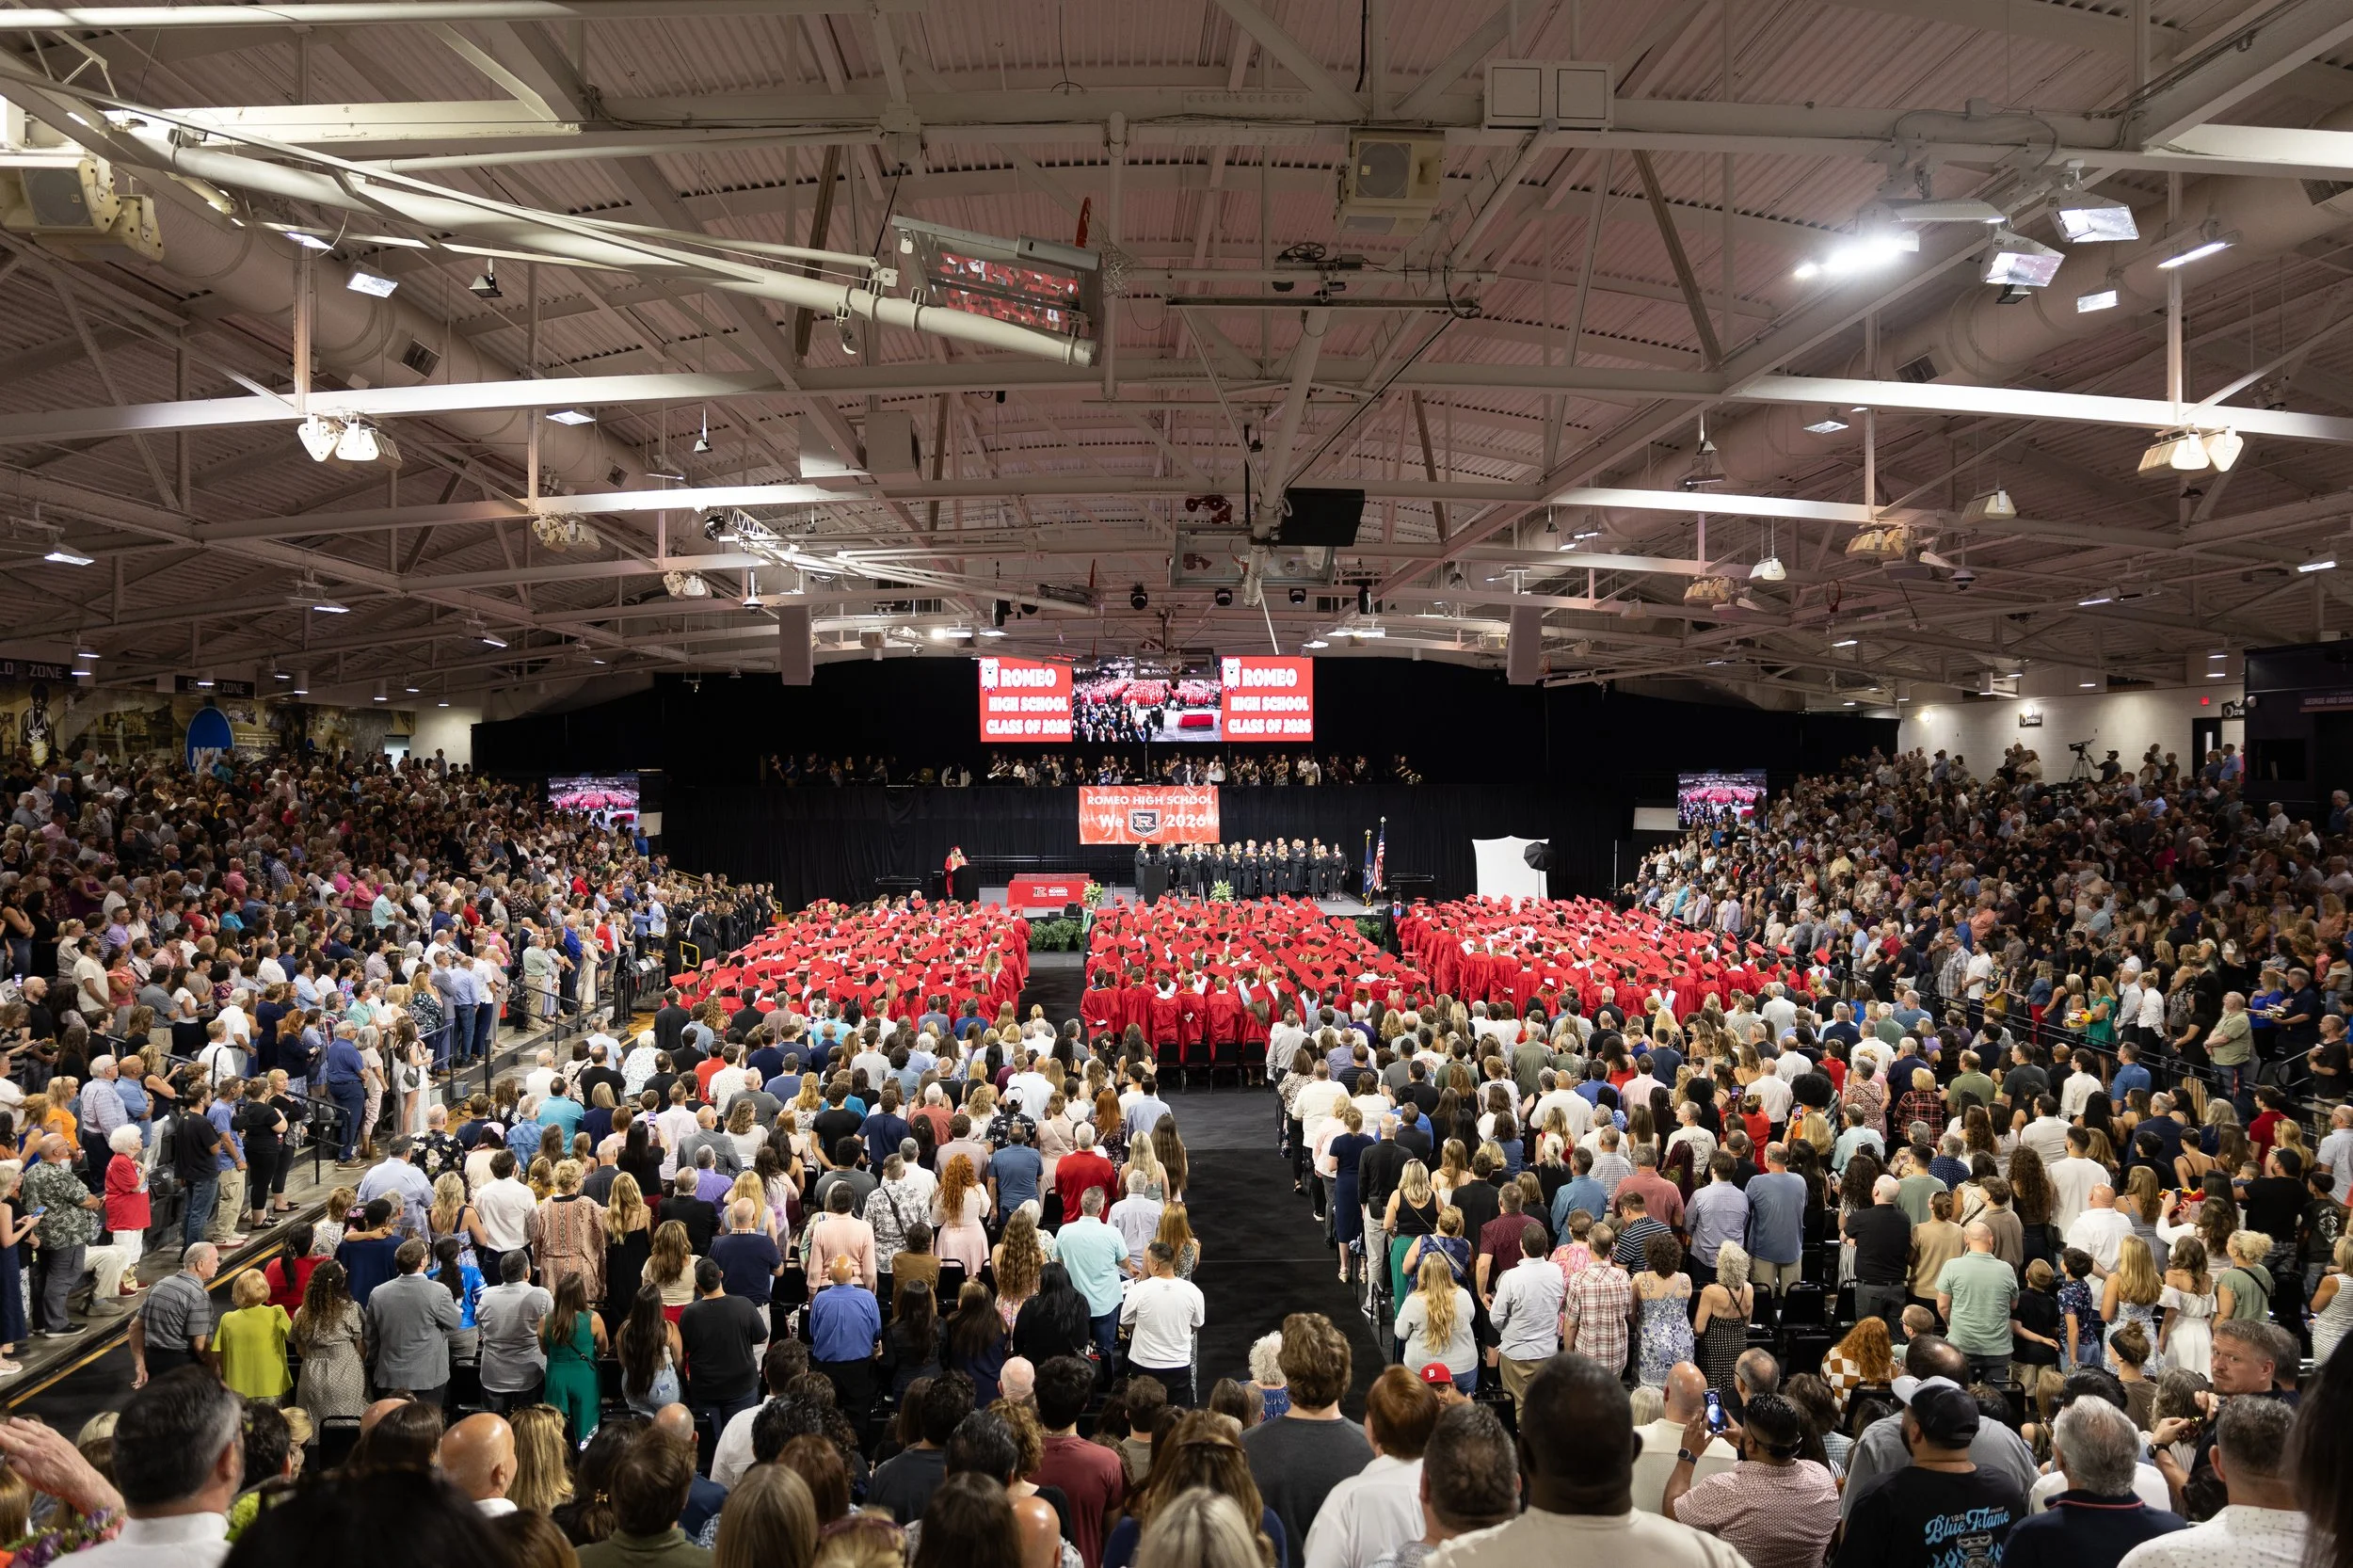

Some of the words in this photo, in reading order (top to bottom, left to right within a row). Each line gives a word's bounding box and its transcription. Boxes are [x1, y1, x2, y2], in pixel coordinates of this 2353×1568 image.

[29, 664, 63, 679] ZONE
[1000, 668, 1056, 687] ROMEO
[1242, 668, 1297, 687] ROMEO
[221, 682, 245, 695] ZONE
[988, 696, 1019, 712] HIGH
[1020, 696, 1068, 712] SCHOOL
[1230, 696, 1260, 712] HIGH
[1262, 696, 1309, 712] SCHOOL
[986, 719, 1023, 734] CLASS
[1024, 719, 1041, 734] OF
[1042, 719, 1071, 734] 2026
[1227, 718, 1265, 733] CLASS
[1266, 718, 1282, 733] OF
[1283, 718, 1311, 733] 2026
[1087, 795, 1129, 805] ROMEO
[1132, 795, 1163, 806] HIGH
[1166, 795, 1214, 805] SCHOOL
[1099, 814, 1125, 827] We
[1165, 814, 1206, 827] 2026
[1925, 1514, 1966, 1545] Blue
[1966, 1507, 2010, 1531] Flame
